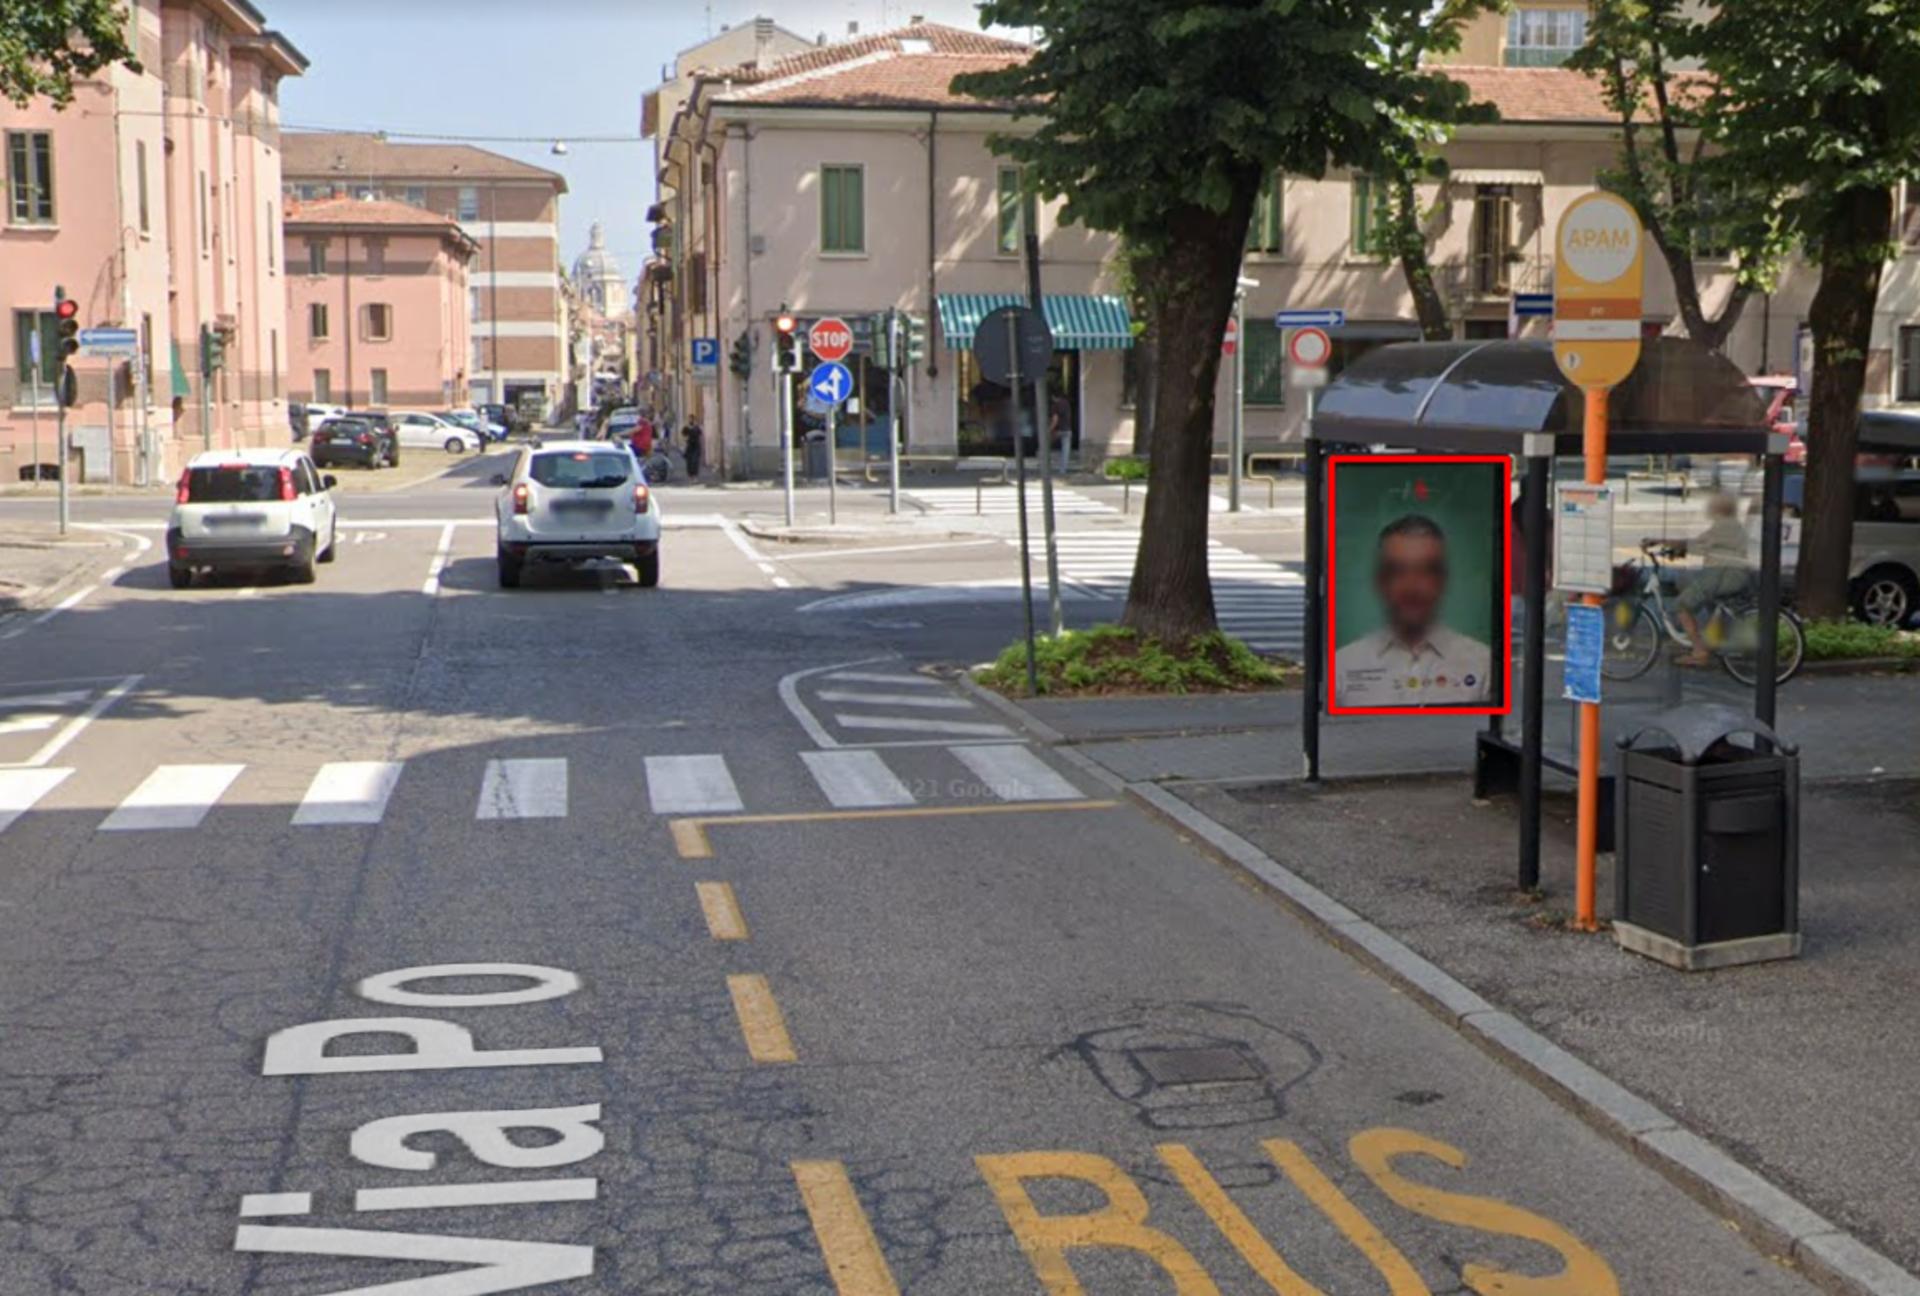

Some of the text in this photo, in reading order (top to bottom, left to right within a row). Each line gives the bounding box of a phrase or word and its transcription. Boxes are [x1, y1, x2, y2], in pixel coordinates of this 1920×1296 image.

[1568, 227, 1630, 249] APAM
[812, 331, 849, 348] STOP
[695, 341, 713, 363] P
[234, 961, 605, 1296] Via Po
[974, 1126, 1620, 1296] BUS
